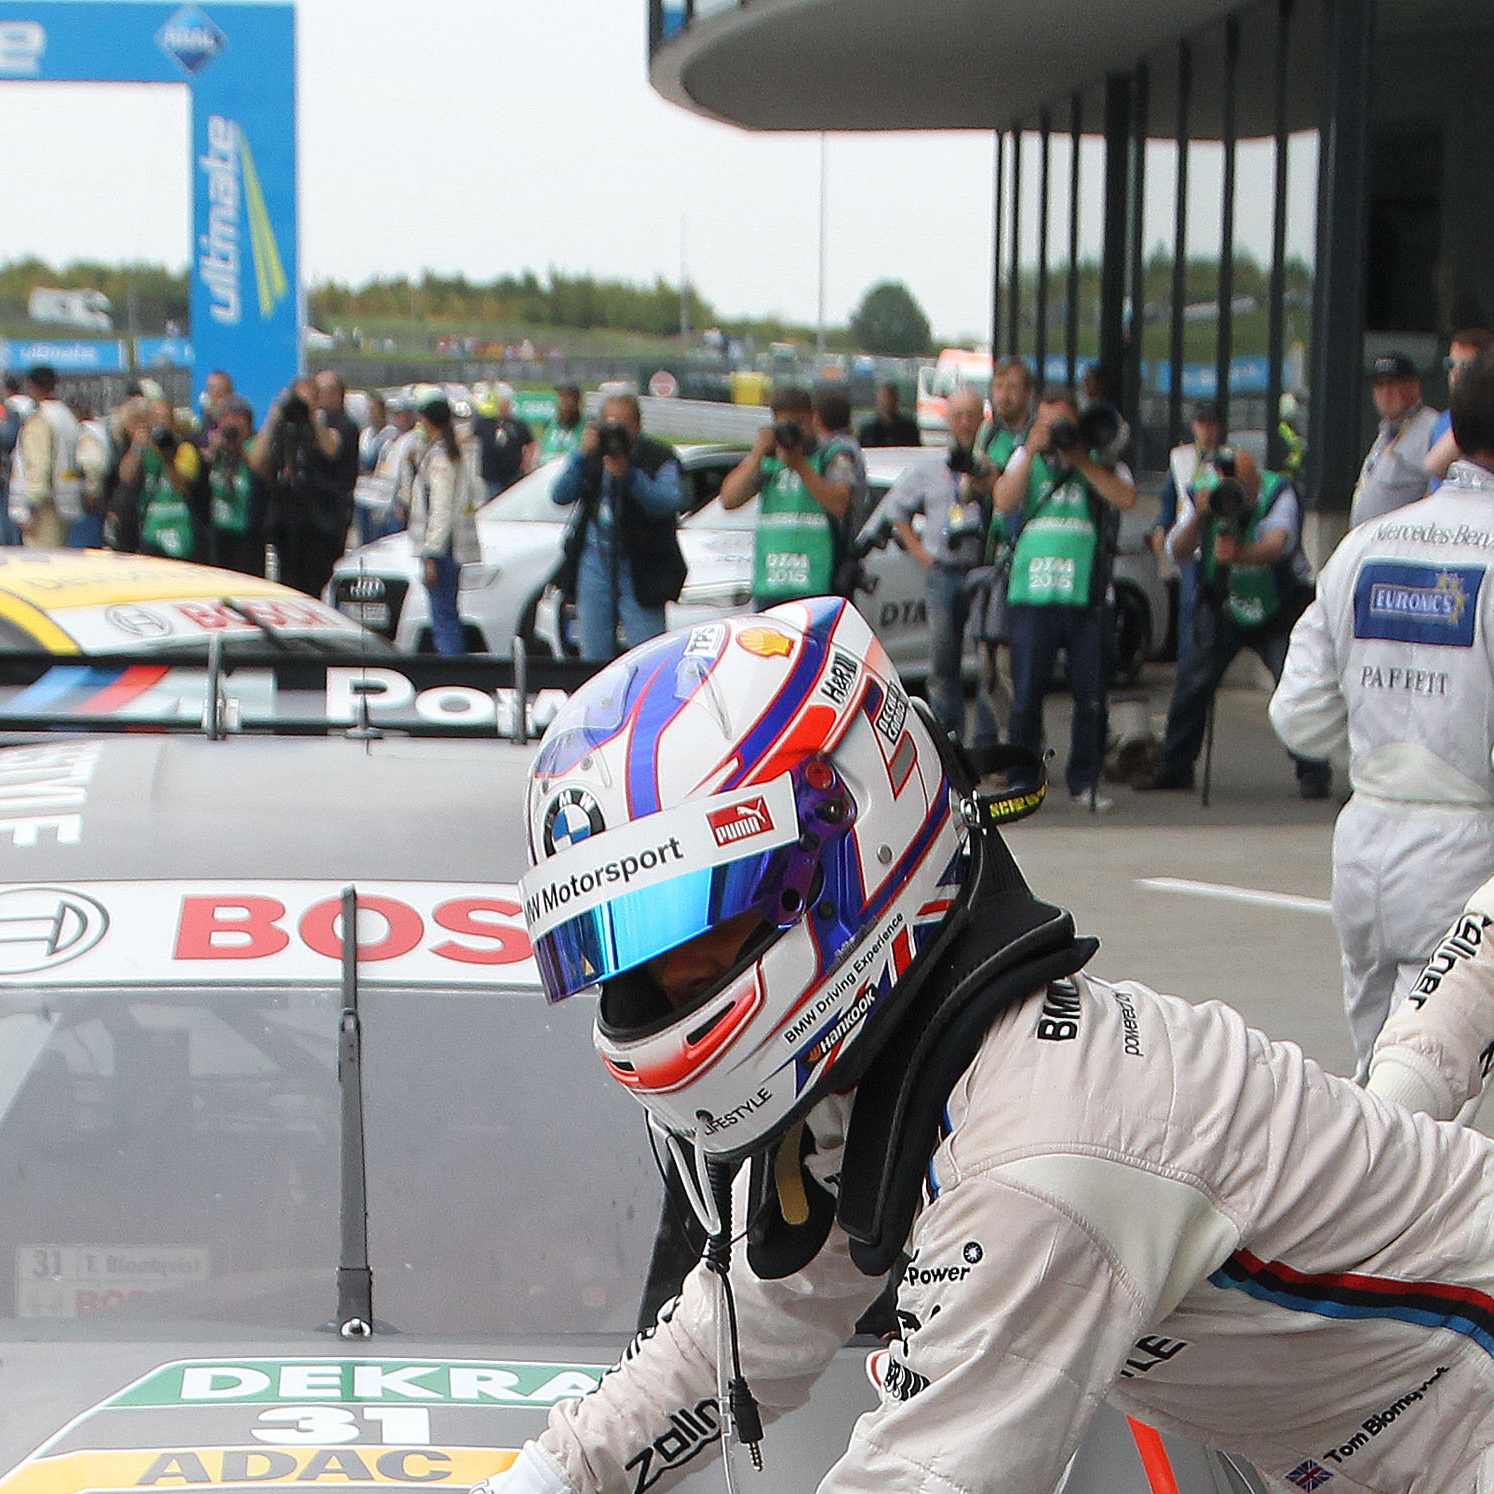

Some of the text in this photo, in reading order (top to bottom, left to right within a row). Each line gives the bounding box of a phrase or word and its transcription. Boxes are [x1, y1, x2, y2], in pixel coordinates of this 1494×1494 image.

[199, 114, 241, 325] ultimate
[326, 667, 572, 728] Pow
[541, 836, 685, 914] Motorsport
[172, 893, 535, 966] BOS
[783, 1010, 818, 1045] BMW
[818, 972, 857, 1015] Driving
[854, 911, 904, 975] Experience
[32, 1249, 62, 1277] 31
[180, 1364, 606, 1404] DEKRA
[250, 1407, 430, 1446] 31
[1323, 1432, 1370, 1465] Tom
[135, 1449, 452, 1486] ADAC
